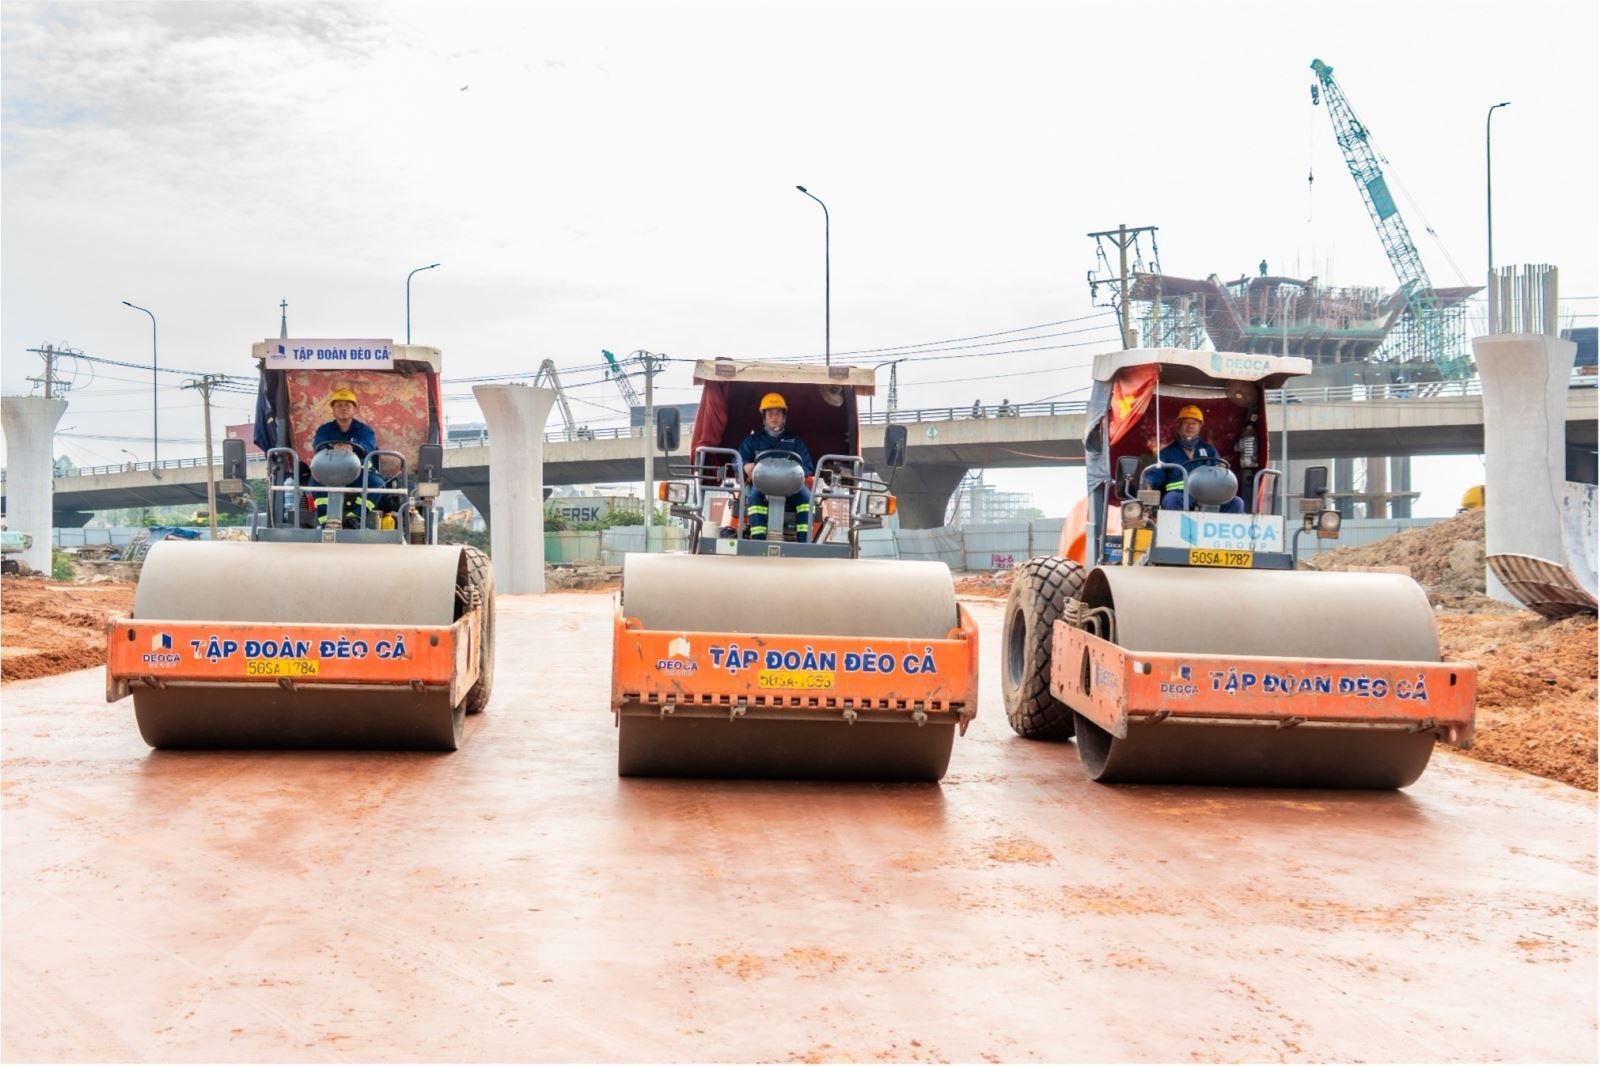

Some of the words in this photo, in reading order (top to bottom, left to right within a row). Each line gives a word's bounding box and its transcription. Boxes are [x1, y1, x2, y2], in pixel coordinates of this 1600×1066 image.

[293, 346, 314, 362] TẬP
[317, 346, 347, 360] ĐOÀN
[350, 346, 372, 360] ĐÈO
[374, 345, 390, 360] CẢ
[1203, 521, 1276, 541] DEOCA
[1213, 540, 1268, 550] GROUP
[1191, 551, 1250, 566] 50SA-1787
[245, 636, 311, 658] ĐOÀN
[320, 636, 368, 658] ĐÈO
[375, 635, 406, 658] CẢ
[143, 654, 181, 662] DEOCA
[659, 660, 698, 671] DEOCA
[709, 644, 758, 673] TẬP
[766, 645, 836, 671] ĐOÀN
[844, 647, 895, 673] ĐÈO
[903, 647, 937, 674] CẢ
